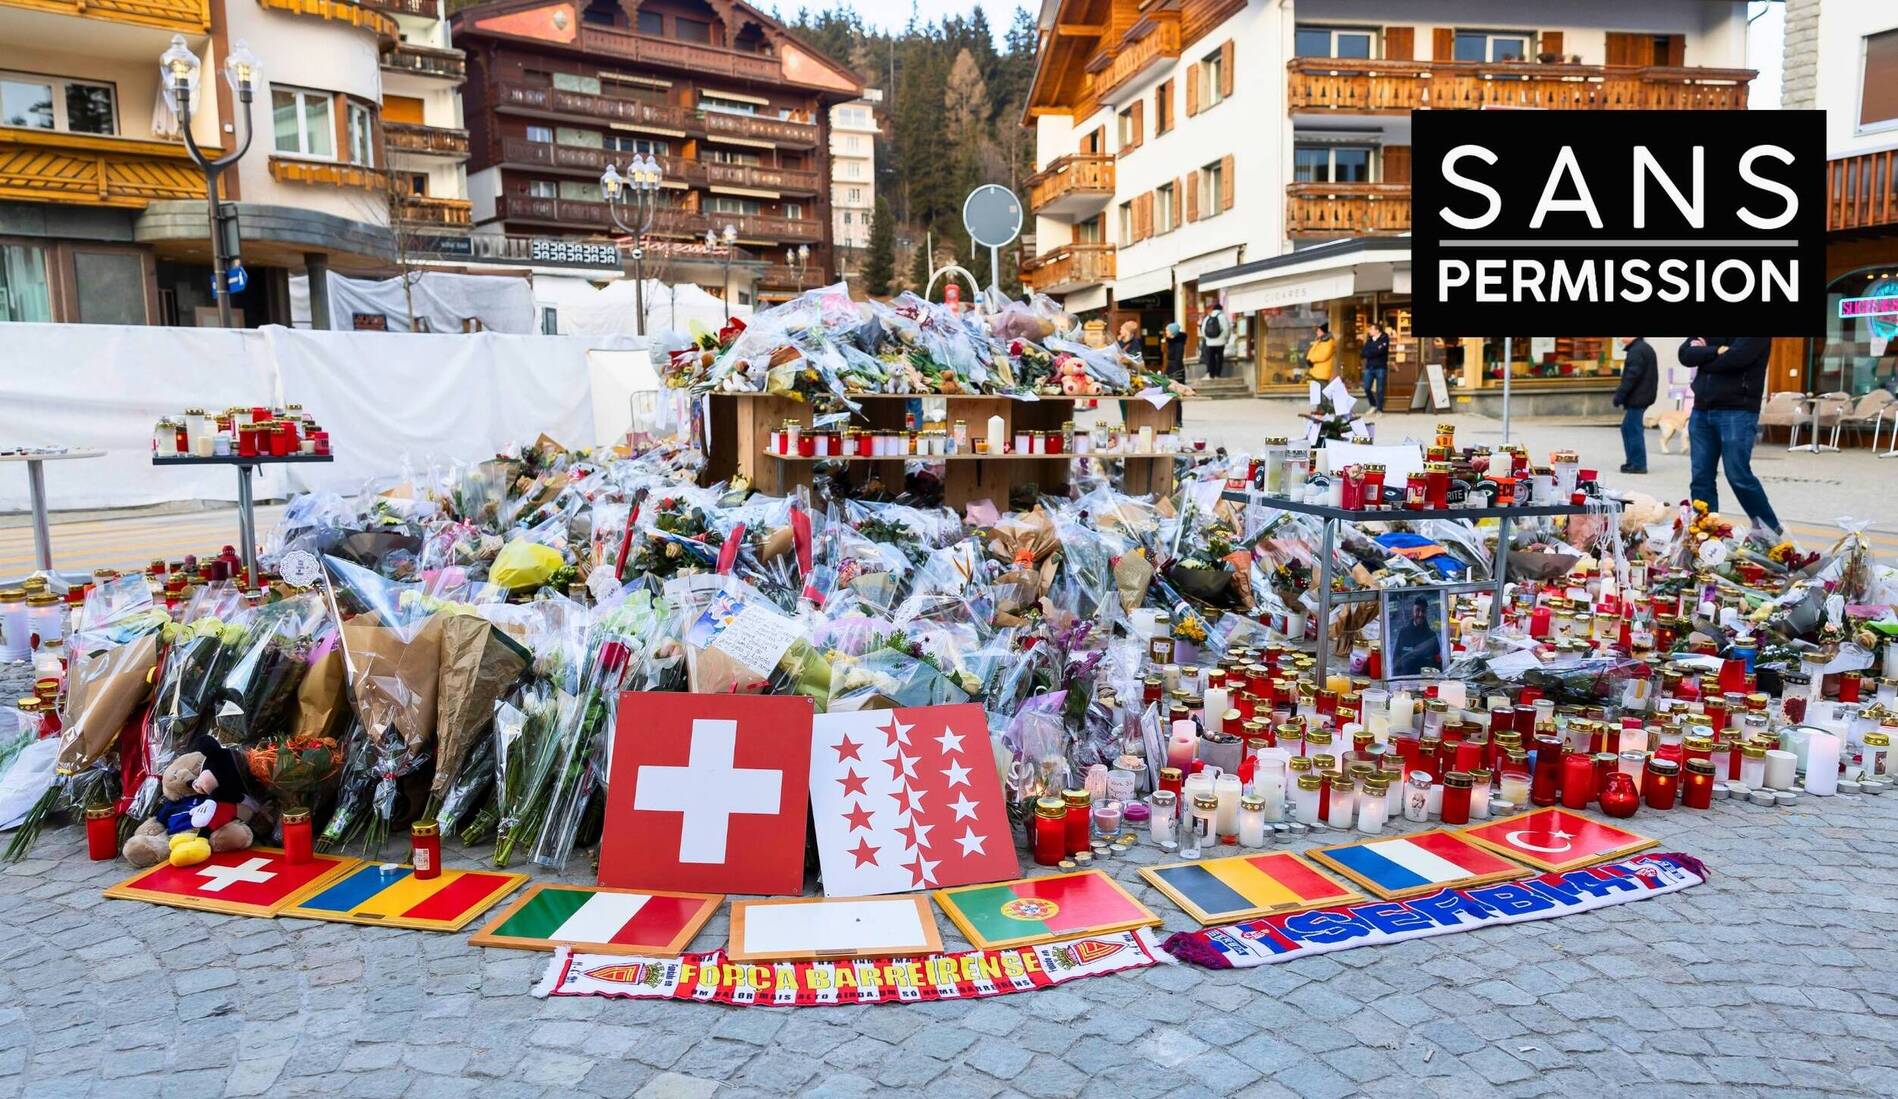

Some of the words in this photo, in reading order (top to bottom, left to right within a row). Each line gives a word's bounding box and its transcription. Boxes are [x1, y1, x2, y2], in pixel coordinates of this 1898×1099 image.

[1284, 869, 1638, 944] SERBIA
[680, 963, 799, 992] FORÇA
[805, 952, 1042, 990] BARREIRENSE
